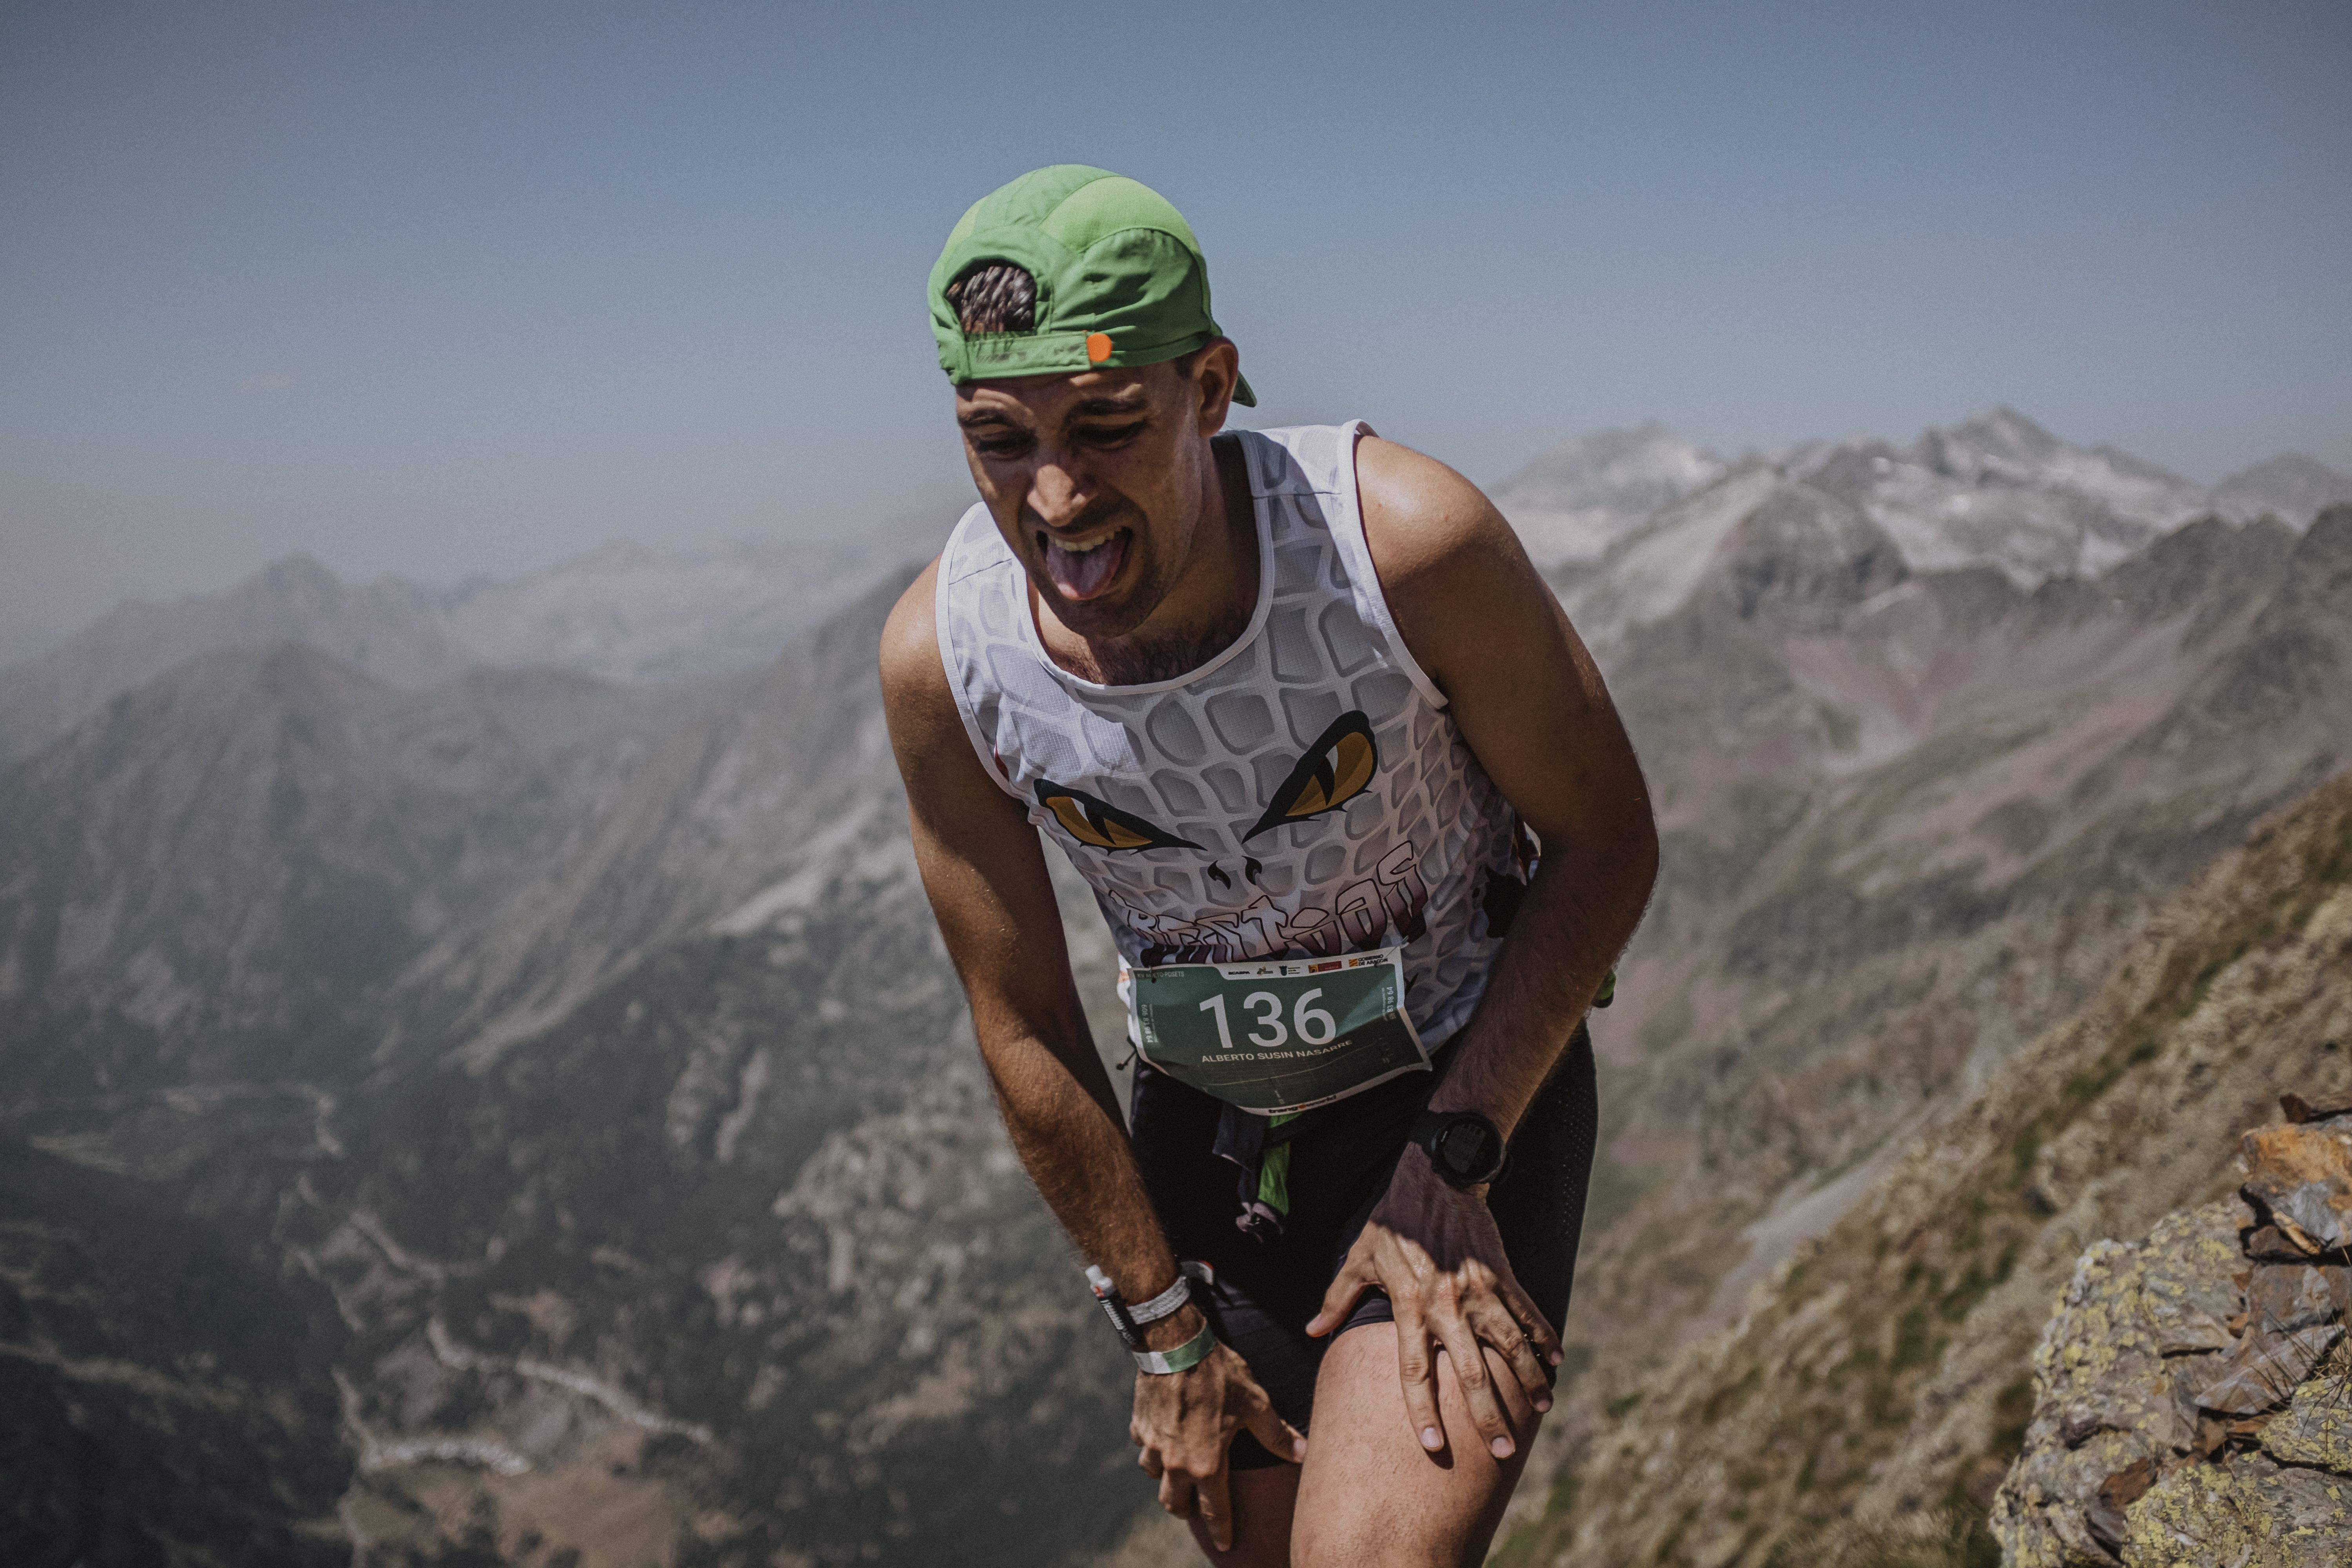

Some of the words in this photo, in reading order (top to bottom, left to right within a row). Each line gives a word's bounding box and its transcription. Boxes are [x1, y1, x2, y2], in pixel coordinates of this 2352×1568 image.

[1358, 954, 1384, 962] GOBIERNO
[1200, 987, 1336, 1048] 136
[1202, 1053, 1254, 1062] ALBERTO
[1257, 1051, 1293, 1060] SUSIN
[1296, 1040, 1352, 1057] NASARRE
